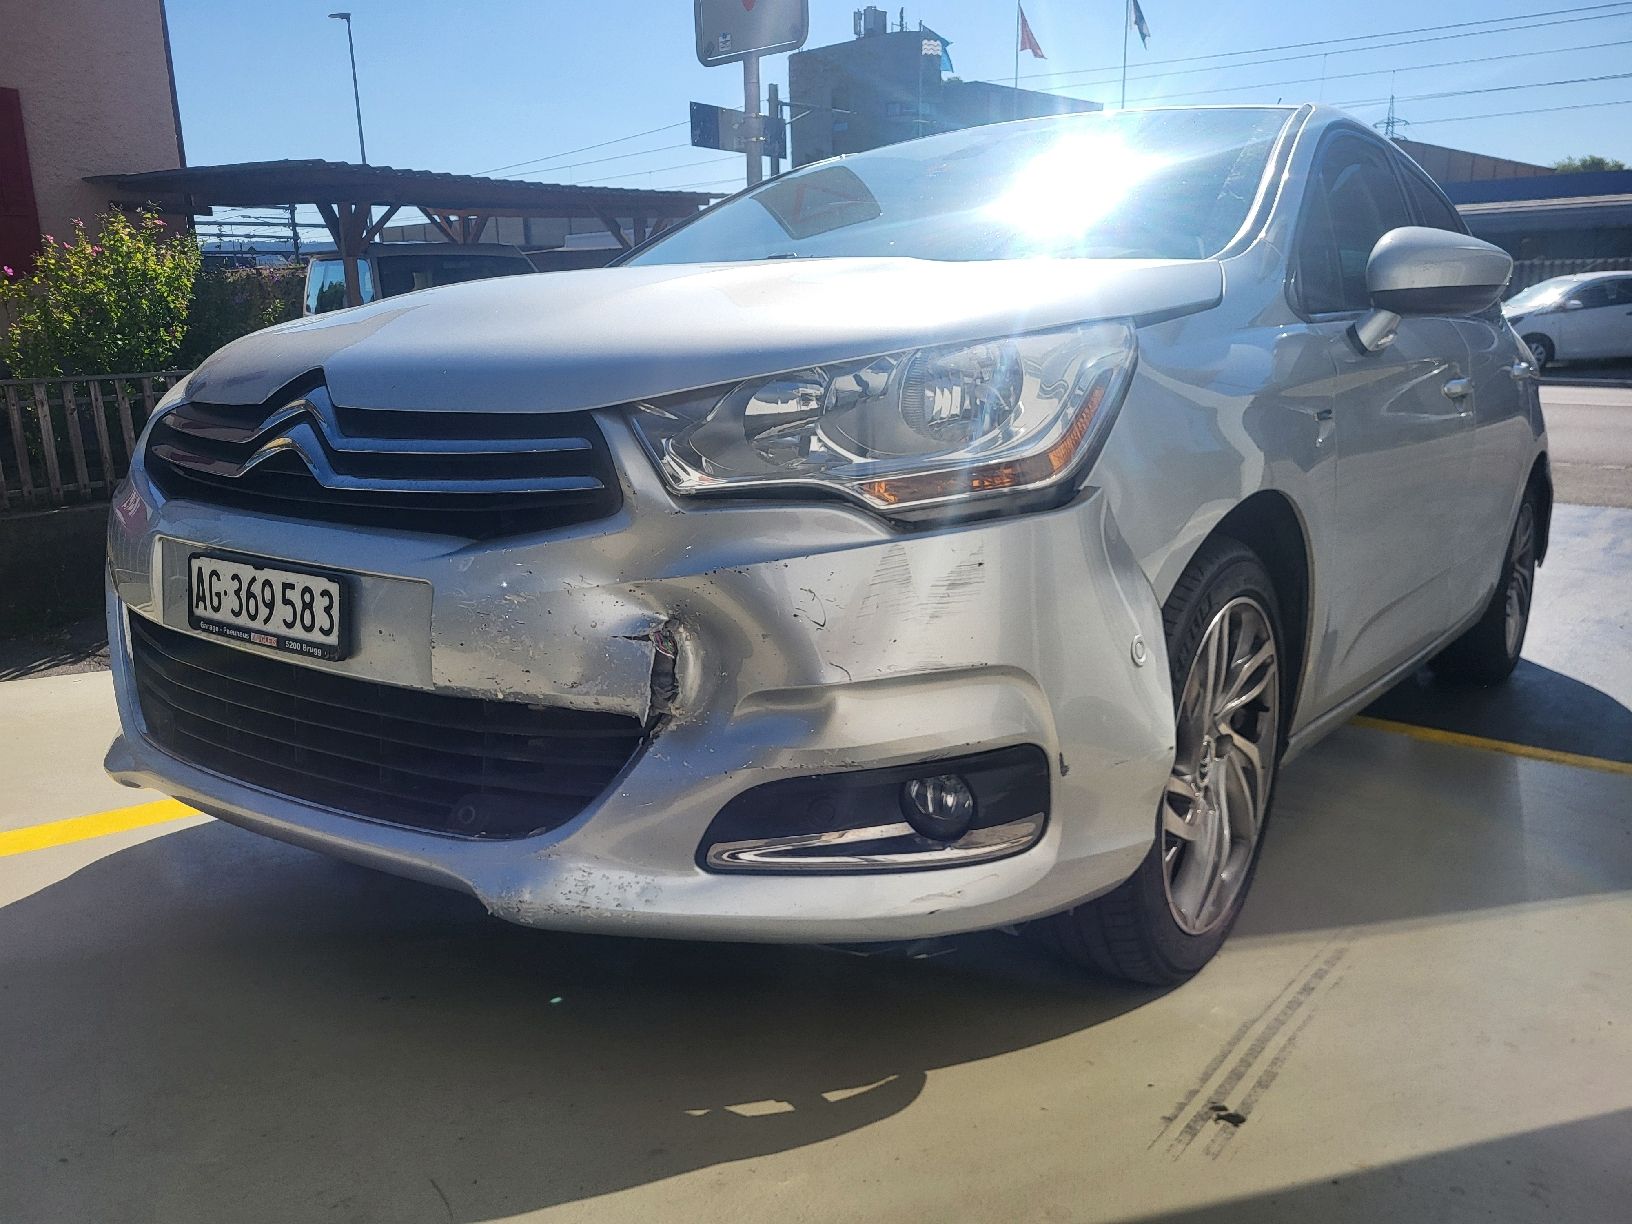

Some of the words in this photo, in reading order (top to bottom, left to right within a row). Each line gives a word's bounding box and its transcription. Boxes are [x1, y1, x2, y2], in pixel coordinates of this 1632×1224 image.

[200, 621, 219, 633] Garage
[285, 640, 301, 651] 5200
[302, 642, 322, 657] Brugg
